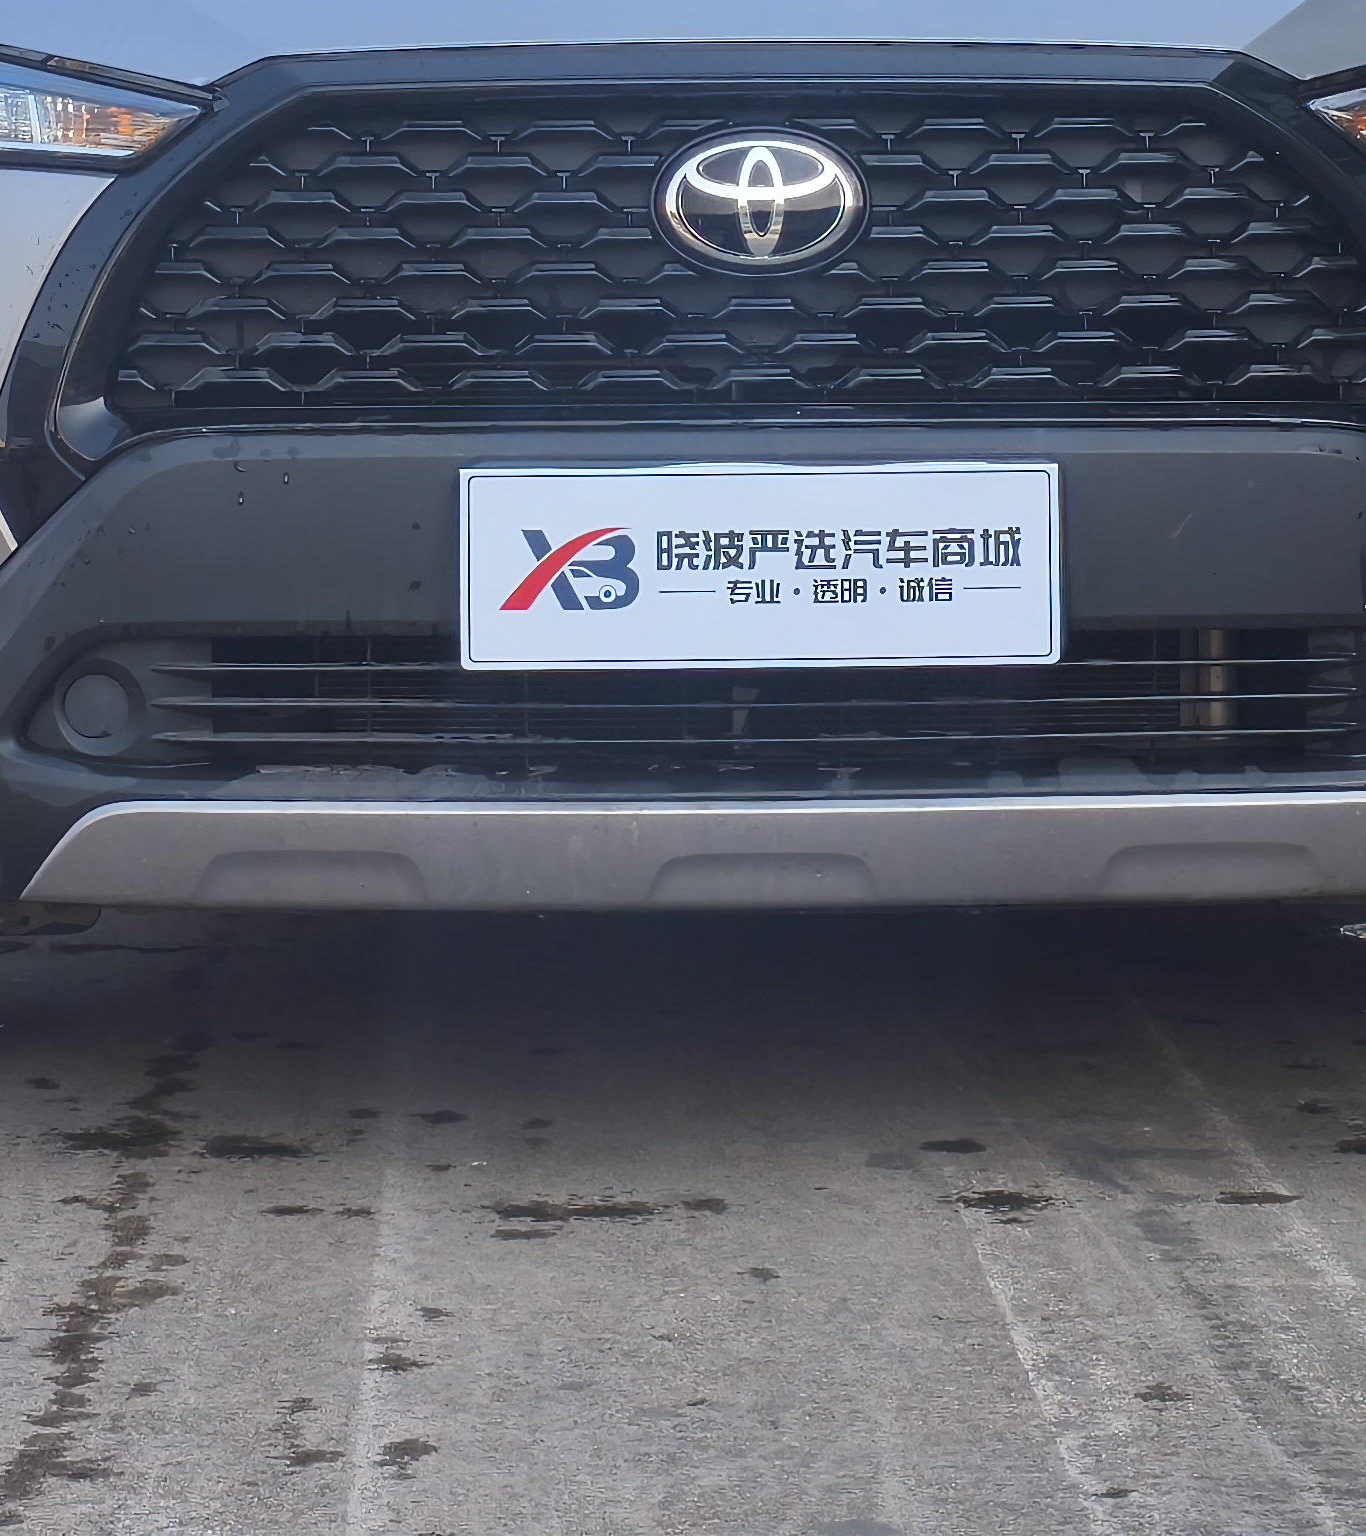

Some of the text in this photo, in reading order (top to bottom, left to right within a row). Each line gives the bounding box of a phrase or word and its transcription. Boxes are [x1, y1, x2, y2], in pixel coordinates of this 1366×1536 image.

[656, 526, 1022, 571] 晓波严选汽车商城
